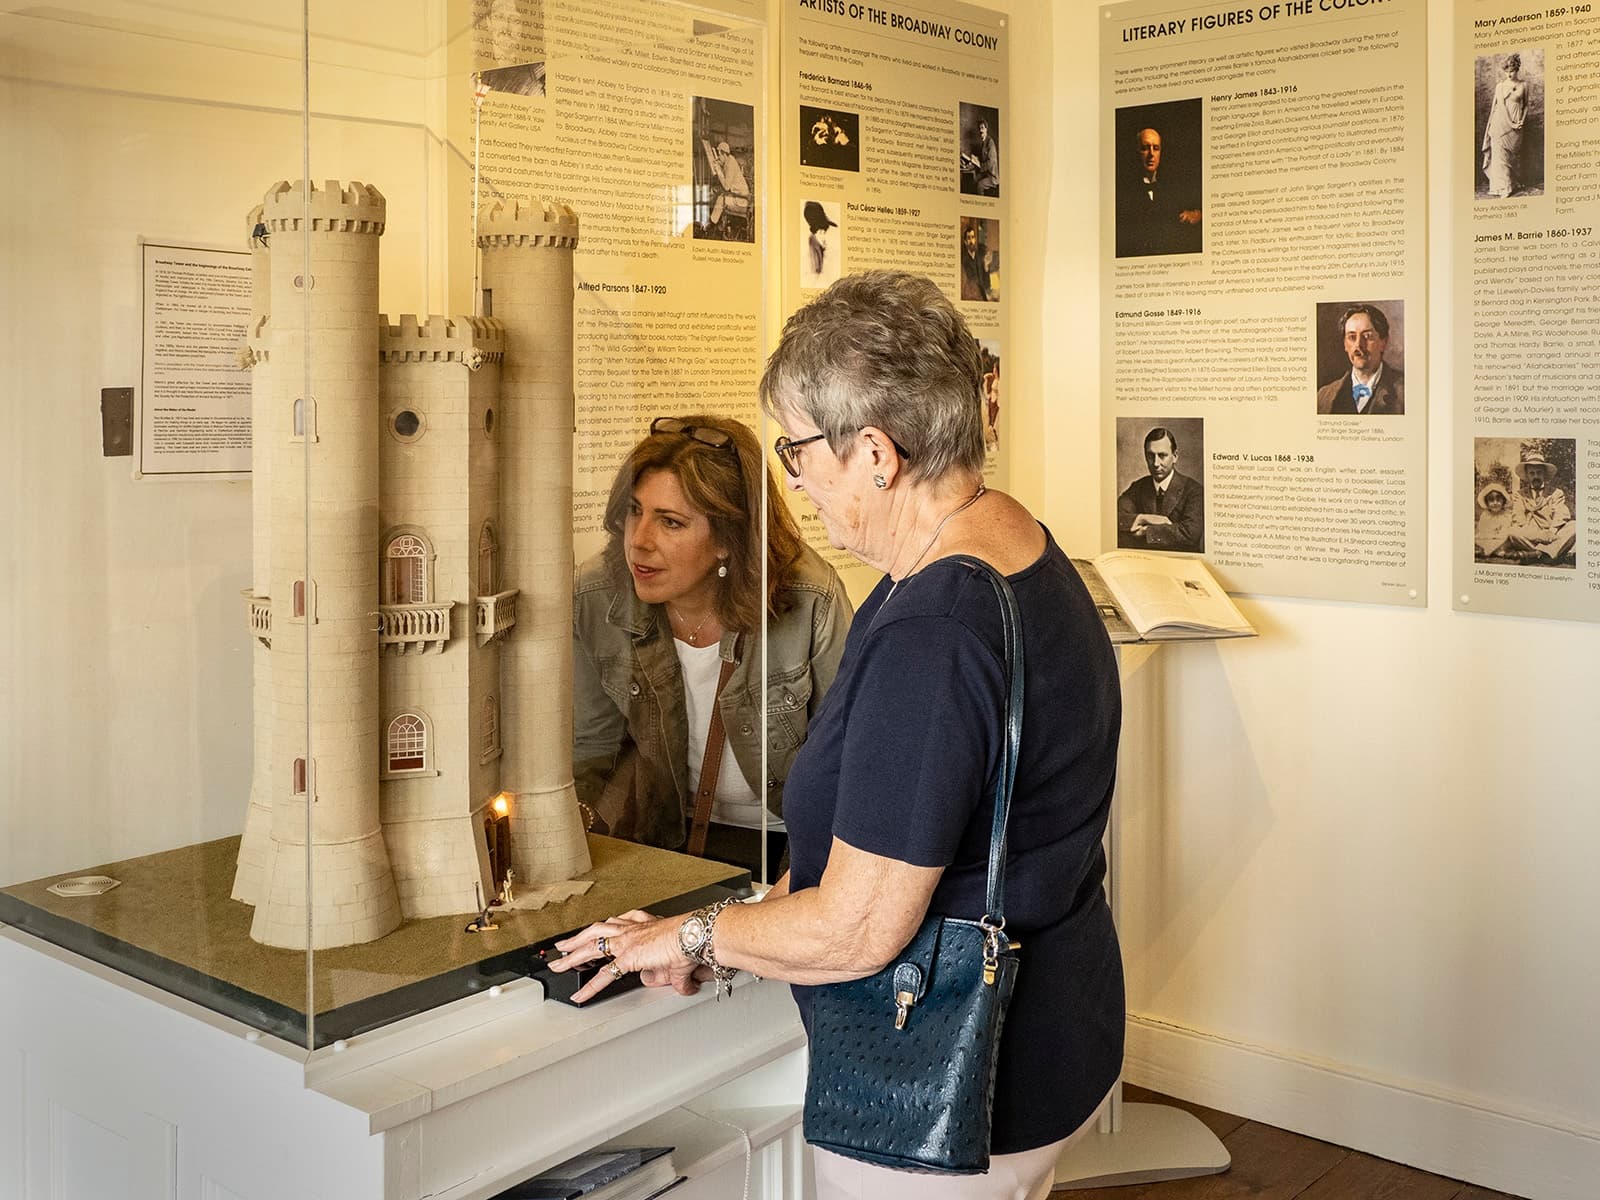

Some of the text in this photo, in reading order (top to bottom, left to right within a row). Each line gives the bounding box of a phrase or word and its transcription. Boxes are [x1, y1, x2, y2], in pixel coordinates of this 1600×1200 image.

[1123, 20, 1185, 42] LITERARY
[1192, 9, 1253, 31] FIGURES
[1259, 5, 1280, 21] OF
[1287, 0, 1312, 17] THE
[1474, 4, 1591, 28] Mary Anderson 1859-1940
[849, 4, 864, 20] OF
[869, 8, 886, 25] THE
[891, 13, 951, 40] BROADWAY
[954, 27, 997, 50] COLONY
[799, 70, 872, 91] Frederick Barnard 1846-96
[1211, 85, 1298, 102] Henry James 1843-1916
[847, 202, 920, 216] Paul César Helleu 1859-1927
[1517, 231, 1543, 240] Barrie
[1547, 228, 1592, 238] 1860-1937
[578, 283, 667, 294] Alfred Parsons 1847-1920
[1167, 308, 1201, 316] 1849-1916
